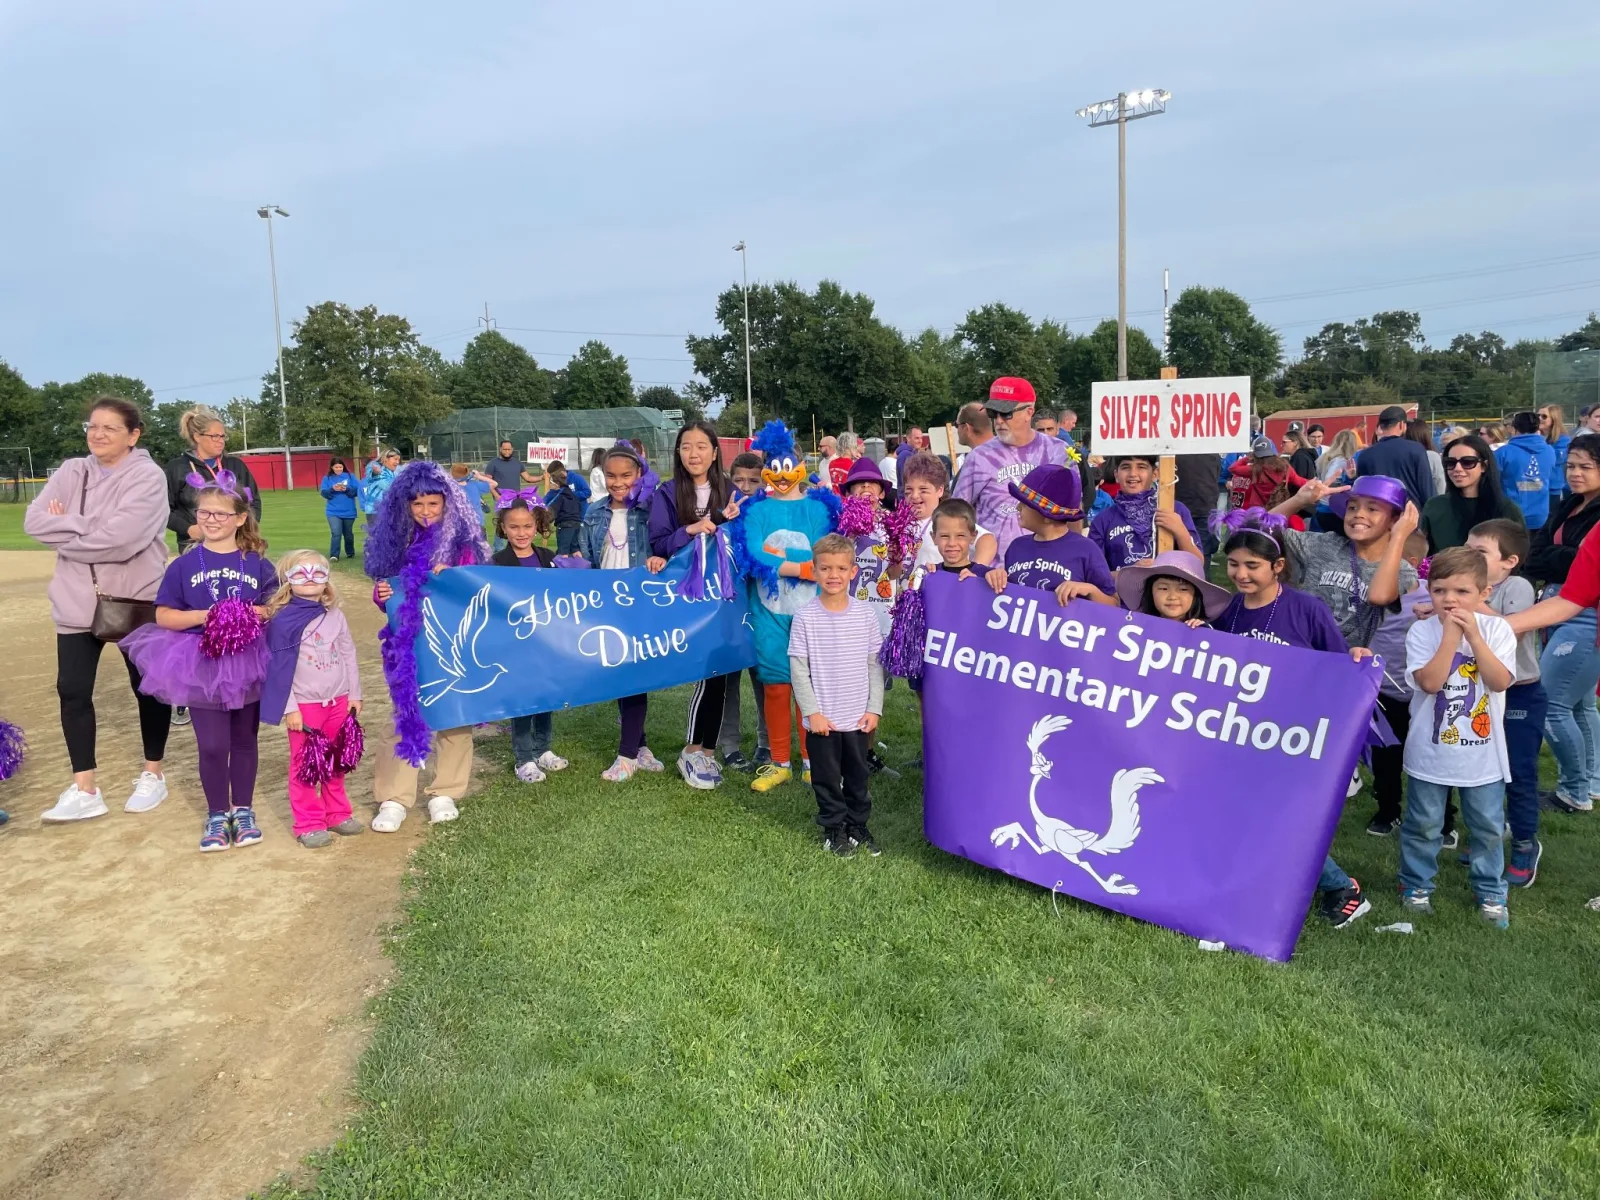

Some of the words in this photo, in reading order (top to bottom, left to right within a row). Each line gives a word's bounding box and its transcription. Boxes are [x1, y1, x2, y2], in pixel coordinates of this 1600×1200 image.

[1099, 395, 1160, 440] SILVER
[1169, 391, 1242, 439] SPRING
[529, 446, 567, 460] WHITEKNACT
[997, 463, 1020, 483] SILVER
[1109, 524, 1133, 540] Silve
[855, 556, 877, 564] Dream
[1007, 560, 1034, 577] Silver
[1034, 558, 1072, 581] Spring
[190, 569, 221, 588] Silver
[1319, 570, 1352, 590] SILVER
[507, 588, 604, 640] Hope
[612, 580, 635, 606] &
[578, 624, 689, 668] Drive
[986, 594, 1106, 653] Silver
[1112, 623, 1272, 704] Spring
[923, 627, 1159, 729] Elementary
[1165, 691, 1330, 760] School
